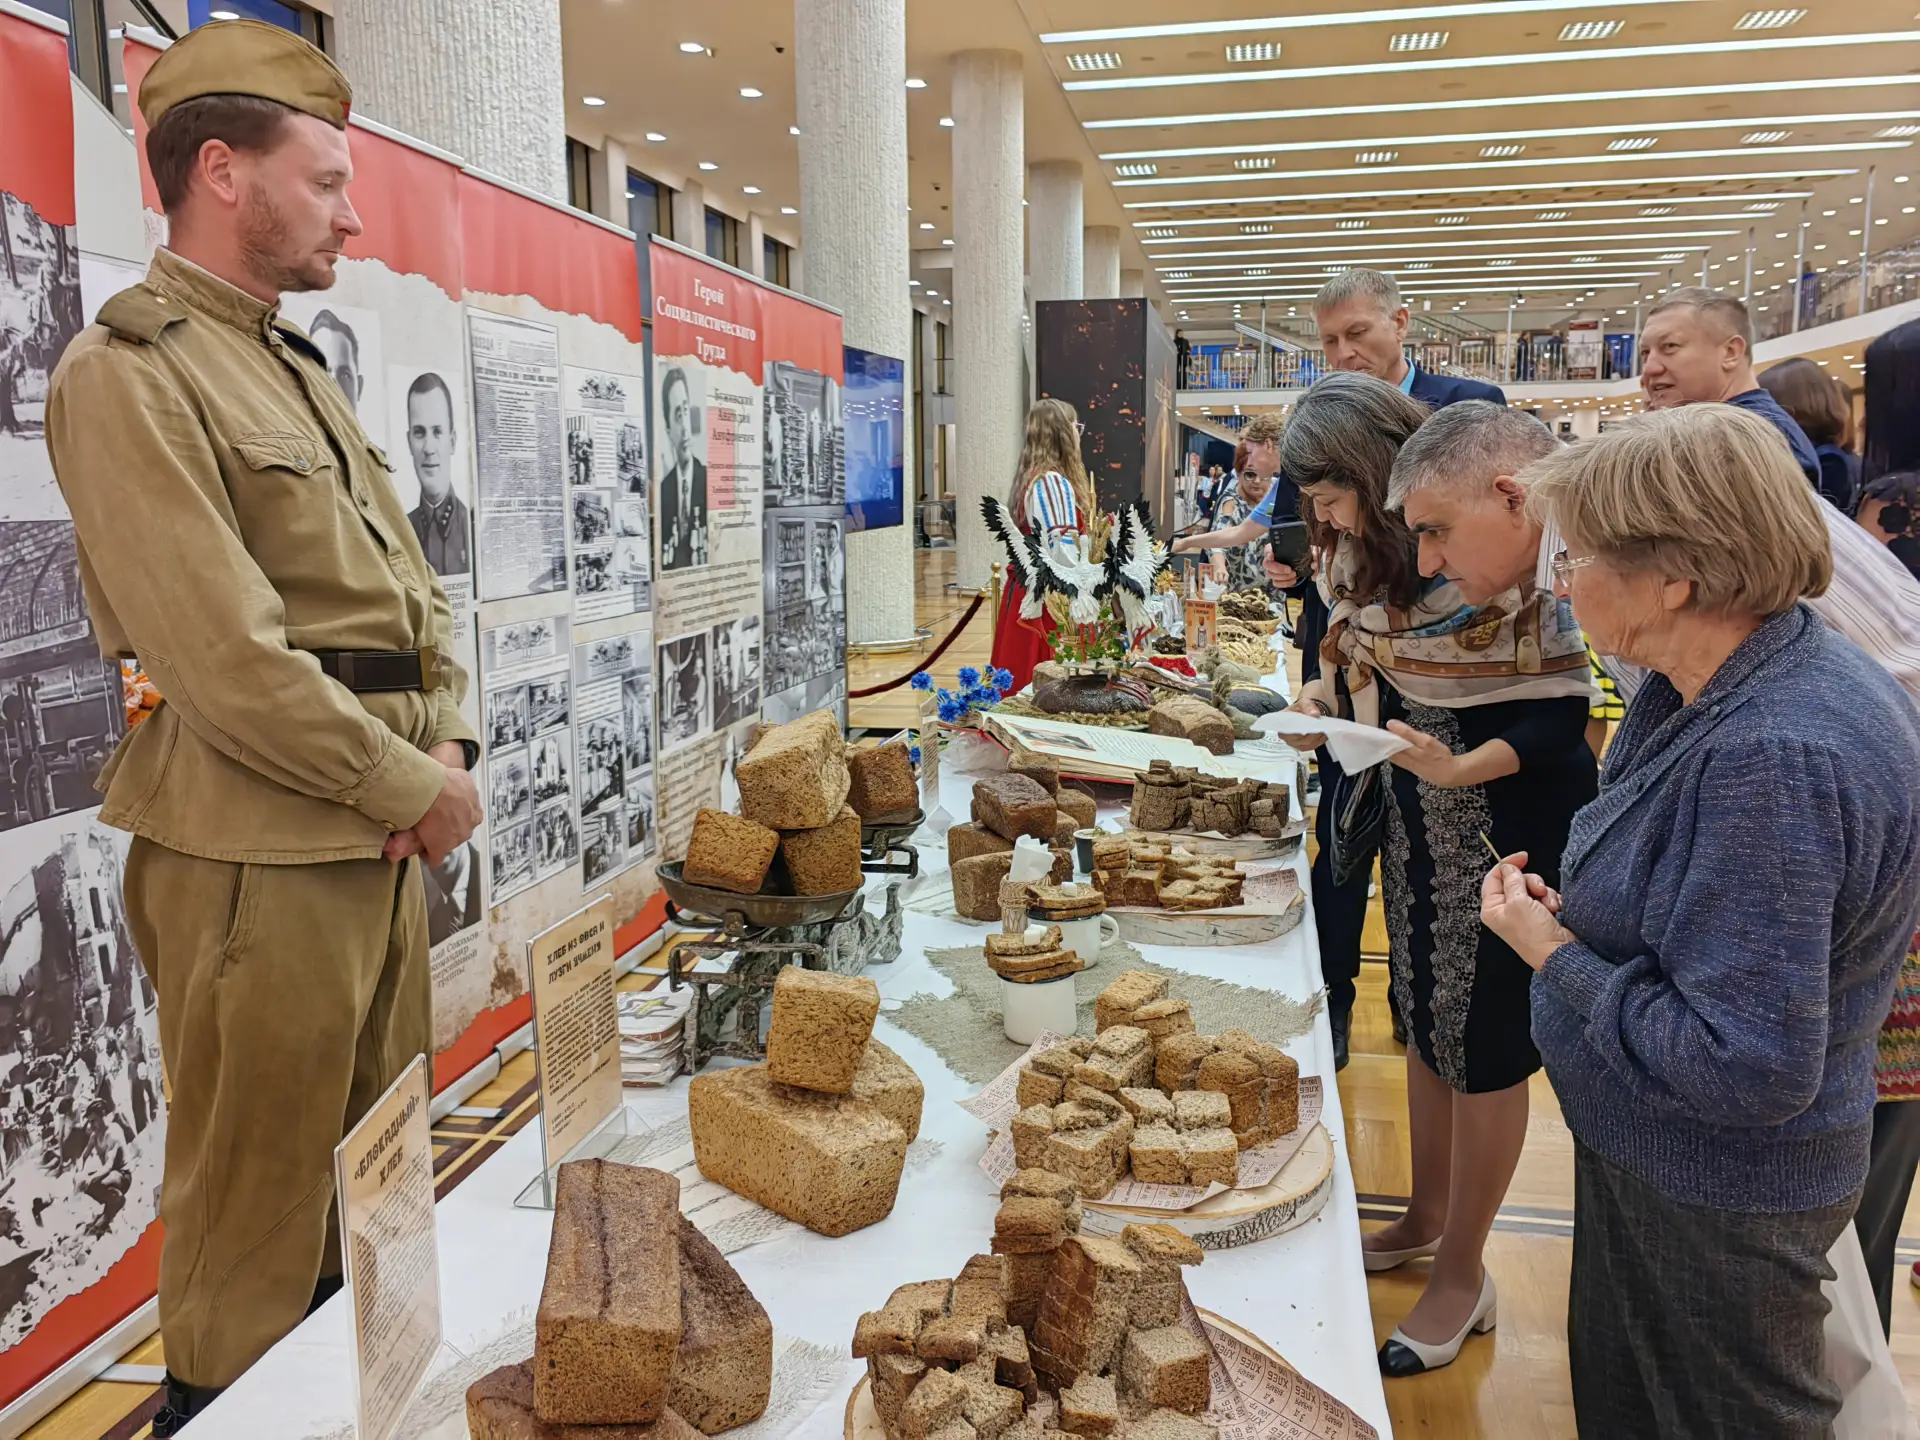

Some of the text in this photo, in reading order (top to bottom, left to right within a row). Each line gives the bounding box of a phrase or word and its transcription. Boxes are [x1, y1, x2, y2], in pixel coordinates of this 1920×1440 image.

[693, 278, 725, 306] Герой
[656, 295, 757, 341] Социалистического
[695, 335, 727, 362] Труда
[447, 931, 479, 953] Соколов
[546, 919, 605, 966] ХЛЕБ ИЗ ОВСА И
[431, 945, 469, 973] командир
[548, 940, 602, 985] ЛУЗГИ ЯЧМЕНЯ
[437, 965, 465, 988] группы
[1299, 1085, 1321, 1094] ХЛЕБ
[354, 1094, 420, 1181] «БЛОКАДНЫЙ»
[379, 1144, 404, 1188] ХЛЕБ
[1214, 1342, 1236, 1360] ХЛЕБ
[1239, 1356, 1262, 1374] ХЛЕБ
[1210, 1371, 1226, 1395] ХЛЕБ
[1267, 1370, 1289, 1389] ХЛЕБ
[1295, 1385, 1316, 1404] ХЛЕБ
[1235, 1405, 1246, 1418] 100
[1257, 1409, 1271, 1420] 100
[1294, 1399, 1314, 1412] ЯНВАРЯ
[1323, 1401, 1346, 1420] ХЛЕБ
[1293, 1408, 1306, 1423] 3 д
[1324, 1414, 1344, 1429] ЯНВАРЯ
[1289, 1427, 1303, 1438] 100
[1324, 1425, 1337, 1440] 2 д
[1351, 1417, 1377, 1438] ХЛЕБ
